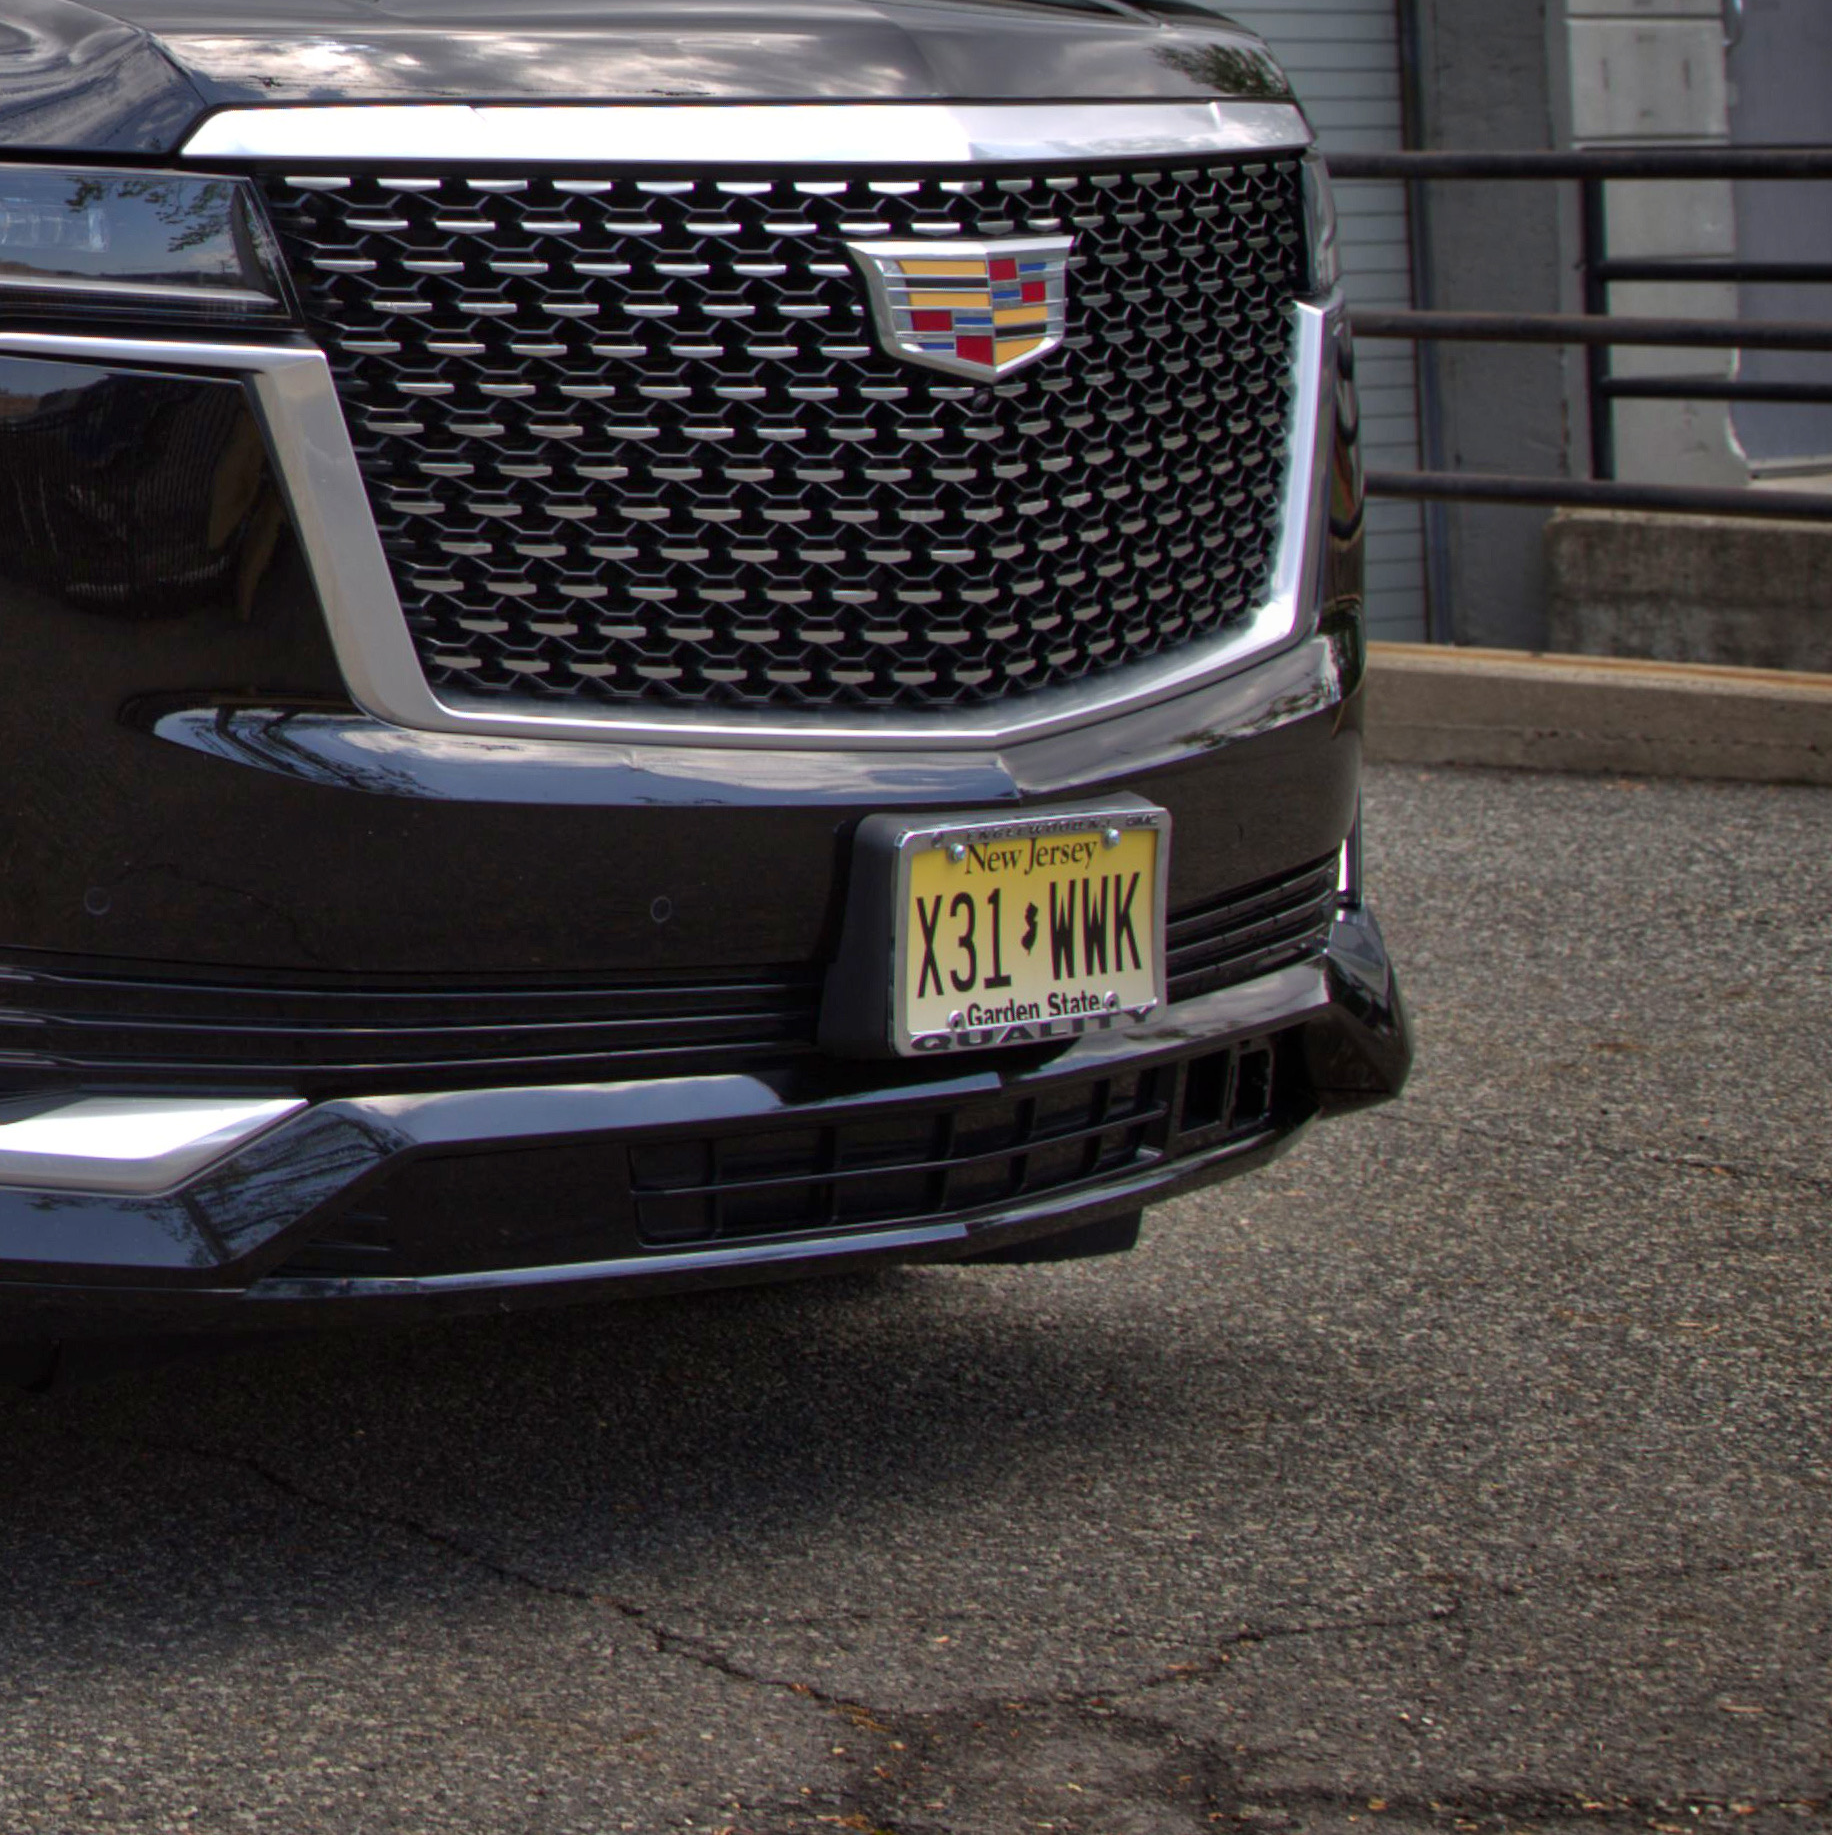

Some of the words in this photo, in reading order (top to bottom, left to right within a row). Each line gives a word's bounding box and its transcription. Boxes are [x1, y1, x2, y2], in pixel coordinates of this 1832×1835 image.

[965, 841, 1023, 875] New
[1024, 837, 1098, 875] Jersey
[916, 887, 1012, 999] X31
[1049, 871, 1142, 981] WWK
[910, 1007, 1152, 1051] QUALITY
[967, 998, 1041, 1027] Garden
[1047, 990, 1101, 1017] State
